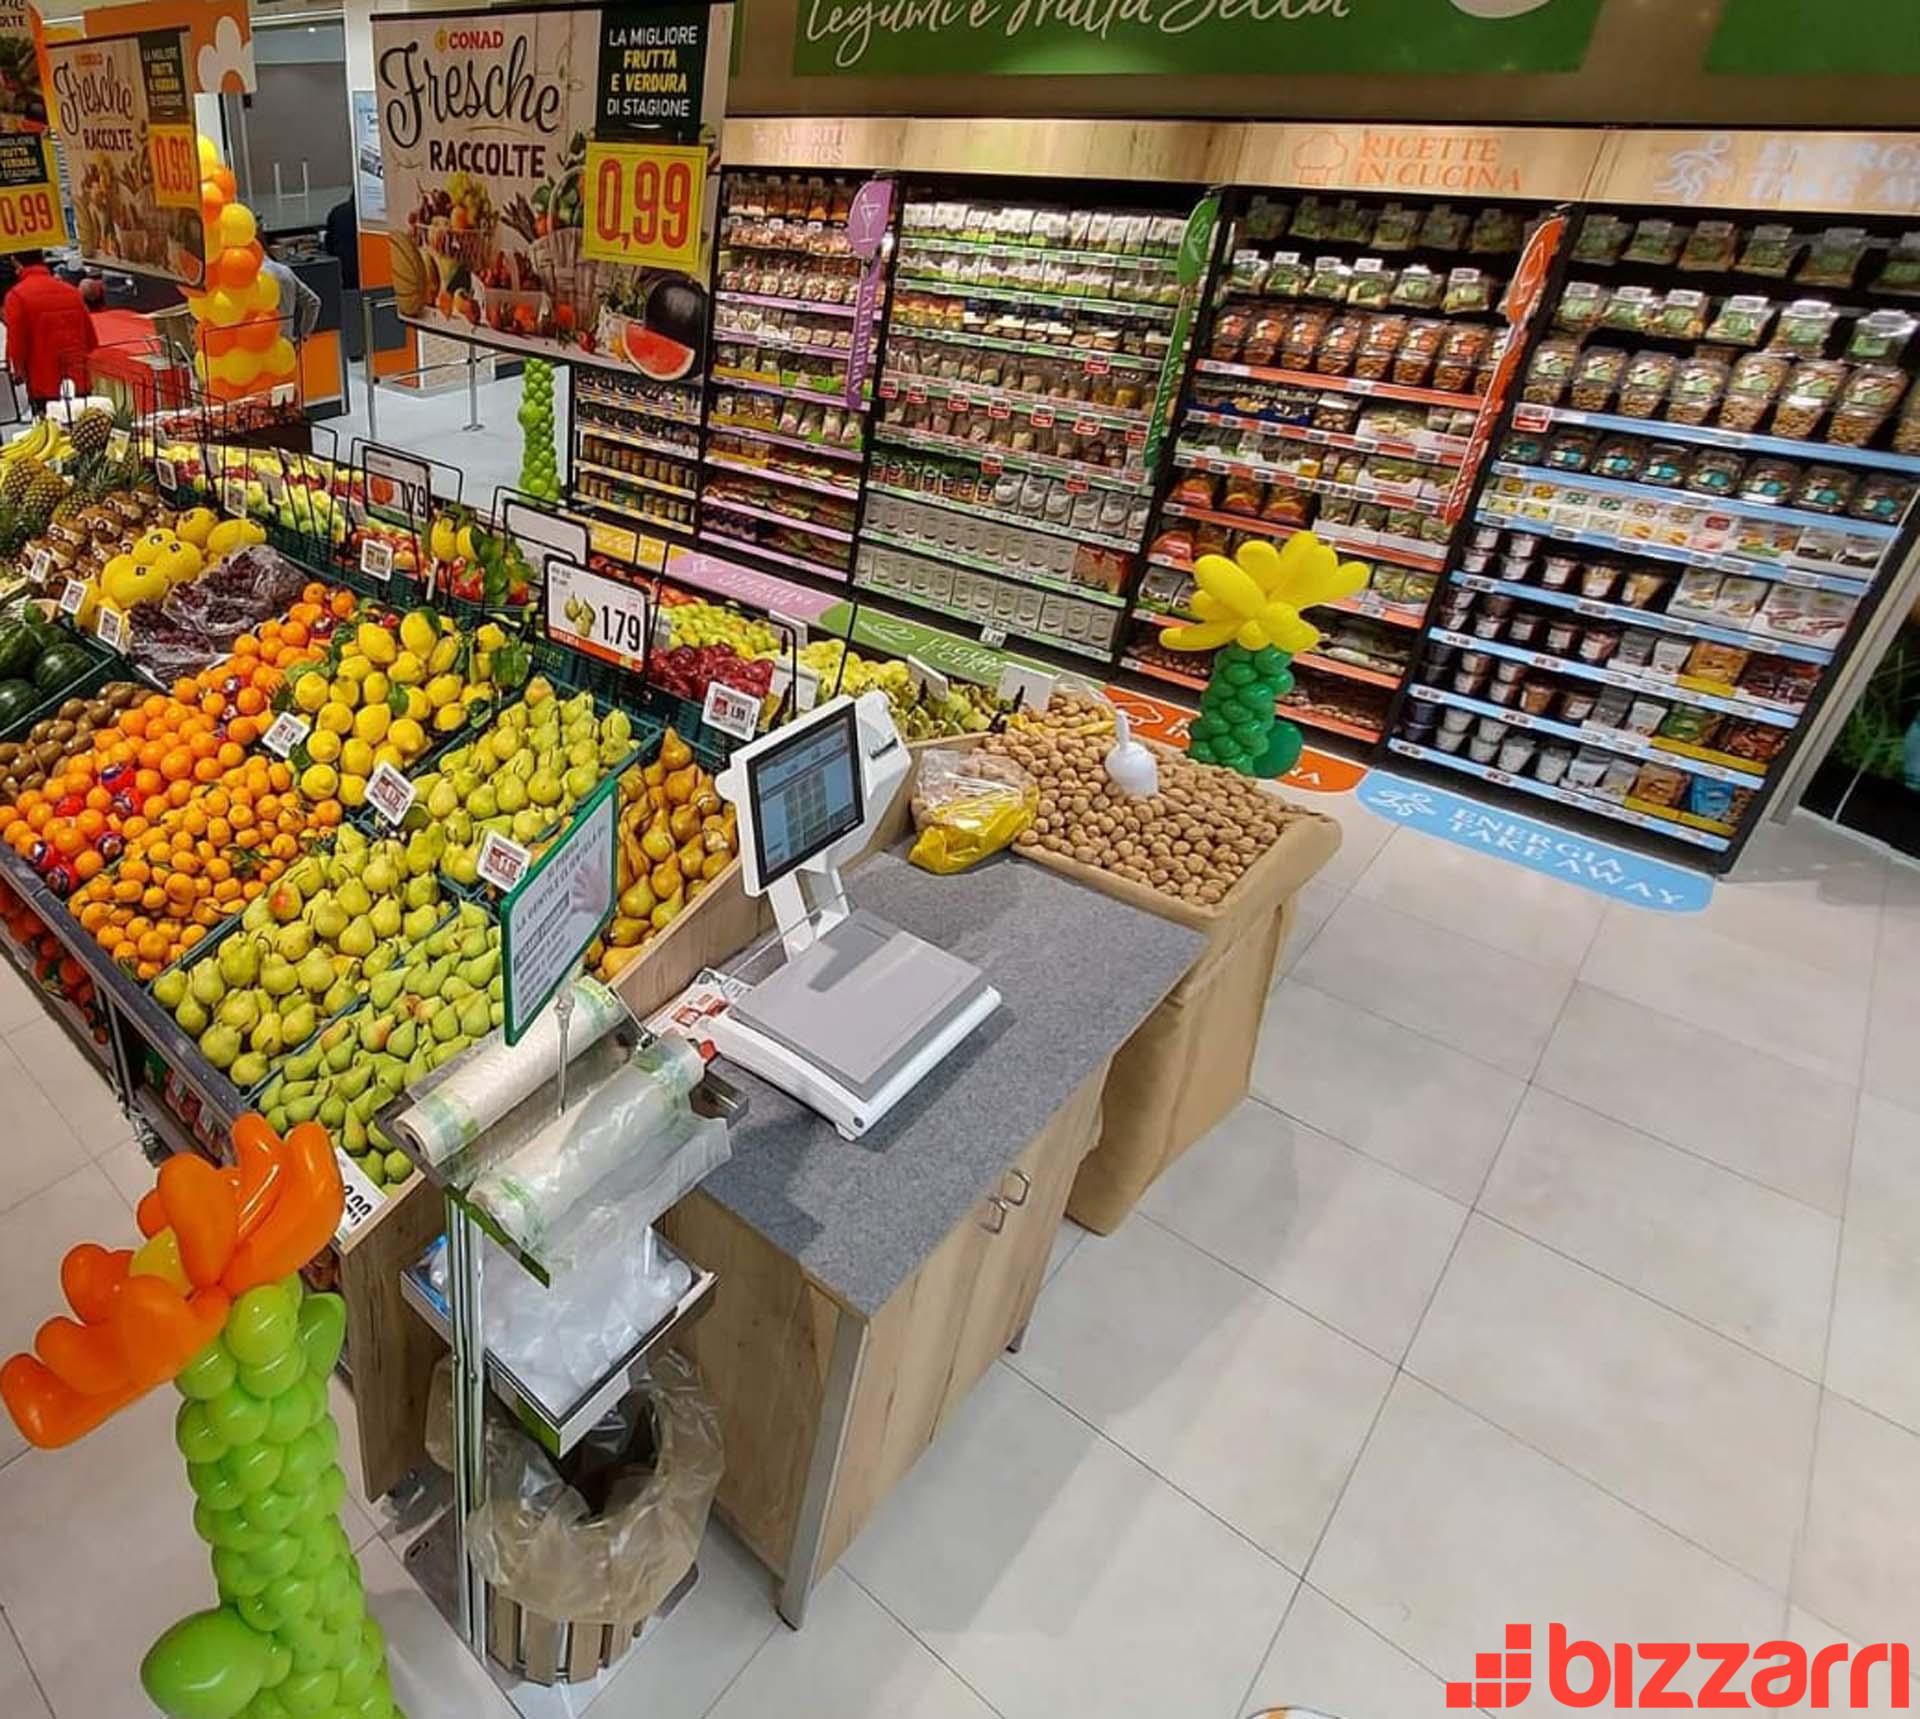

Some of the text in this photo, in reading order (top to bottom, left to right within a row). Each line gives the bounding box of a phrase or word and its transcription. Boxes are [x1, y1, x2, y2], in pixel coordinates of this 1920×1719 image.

[448, 29, 504, 51] CONAD
[608, 25, 698, 47] LA MIGLIORE
[623, 48, 678, 70] FRUTTA
[53, 55, 134, 136] Fresche
[379, 35, 561, 150] Fresche
[610, 71, 688, 93] E VERDURA
[606, 97, 691, 118] DI STAGIONE
[83, 128, 134, 152] RACCOLTE
[428, 139, 546, 179] RACCOLTE
[1360, 131, 1502, 162] RICETTE
[154, 134, 194, 193] 0,99
[1354, 162, 1522, 191] IN CUCINA
[1, 191, 54, 237] 0,99
[595, 158, 692, 251] 0,99
[602, 605, 641, 652] 1,79
[1447, 817, 1685, 906] TAKE AWAY
[1453, 808, 1624, 875] ENERGIA
